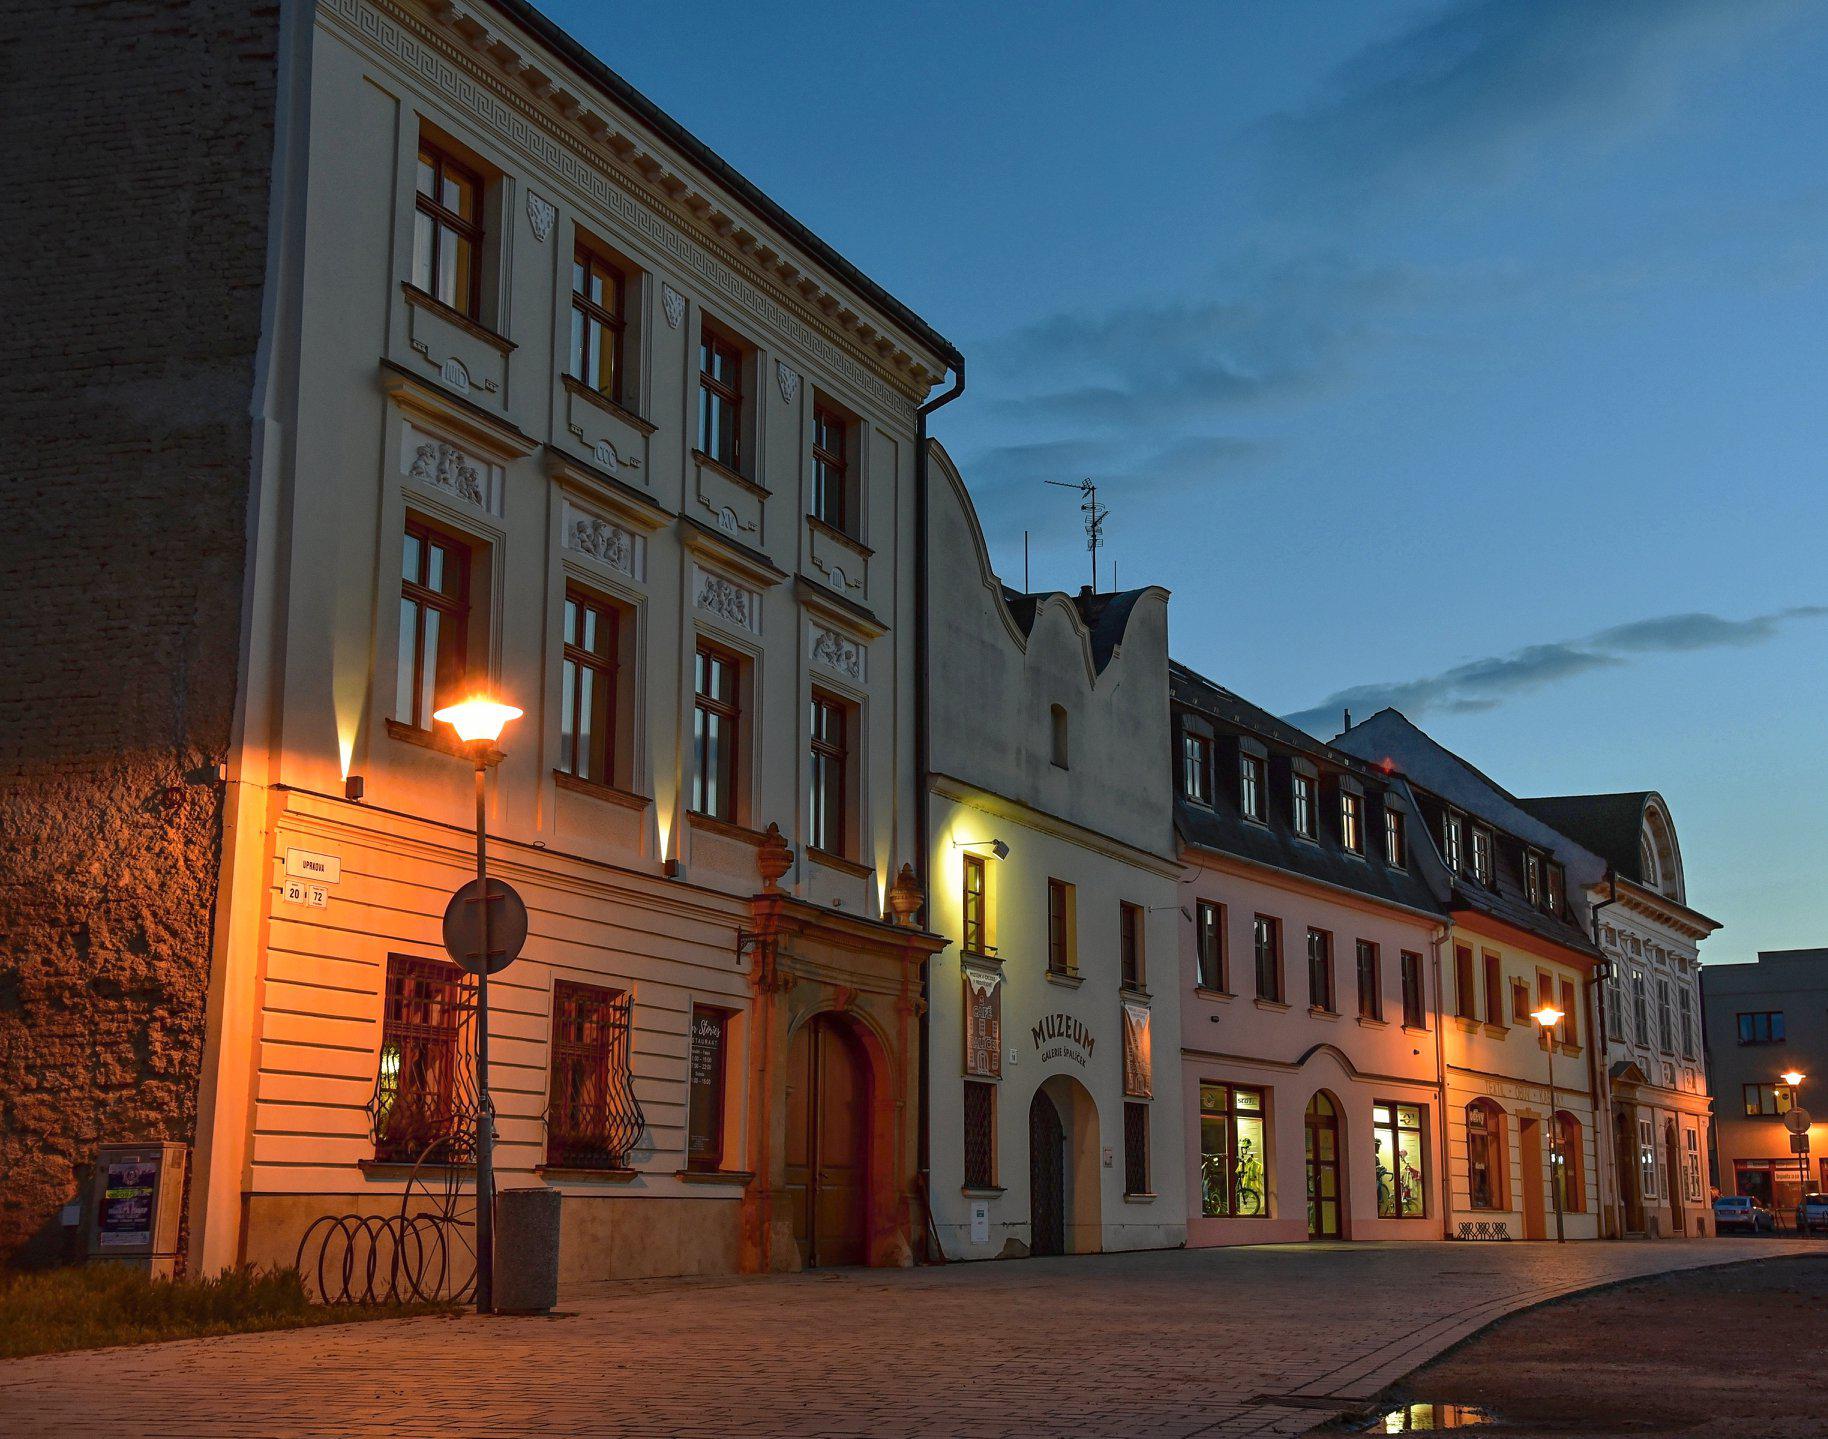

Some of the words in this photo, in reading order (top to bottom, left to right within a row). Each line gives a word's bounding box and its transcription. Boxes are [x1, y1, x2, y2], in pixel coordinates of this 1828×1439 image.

[289, 888, 300, 899] 20
[313, 892, 323, 902] 72
[699, 1019, 721, 1037] Stories
[1030, 1013, 1096, 1059] MUZEUM
[1041, 1047, 1062, 1063] GALERIE
[1063, 1046, 1087, 1069] ŠPALÍČEK
